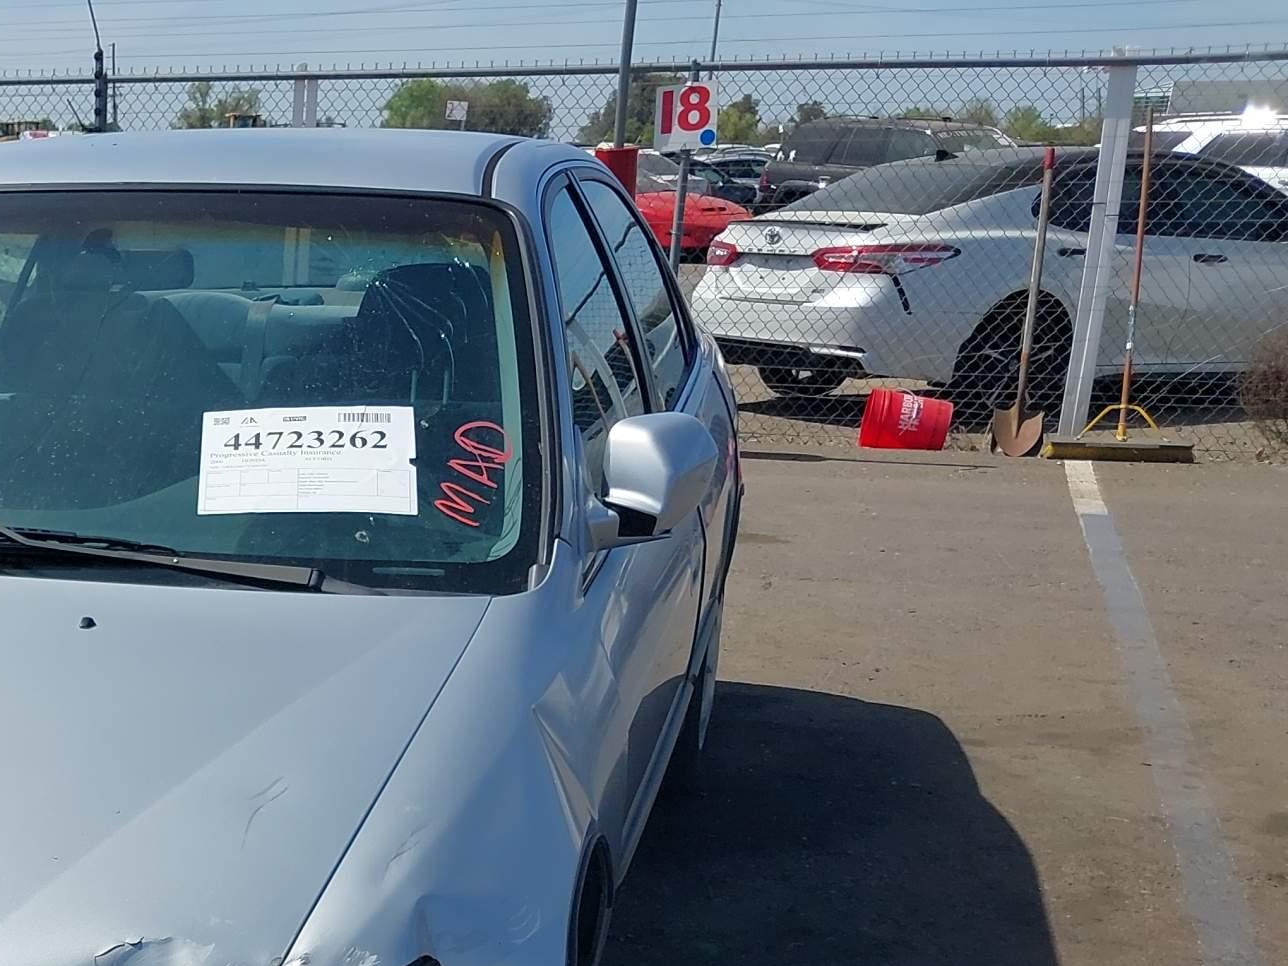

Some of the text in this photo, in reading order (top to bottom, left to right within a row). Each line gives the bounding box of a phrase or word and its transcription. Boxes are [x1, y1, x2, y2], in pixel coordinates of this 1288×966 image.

[661, 86, 710, 134] 18
[224, 430, 388, 450] 44723262
[261, 449, 297, 457] Casualty
[300, 448, 342, 456] Insurance
